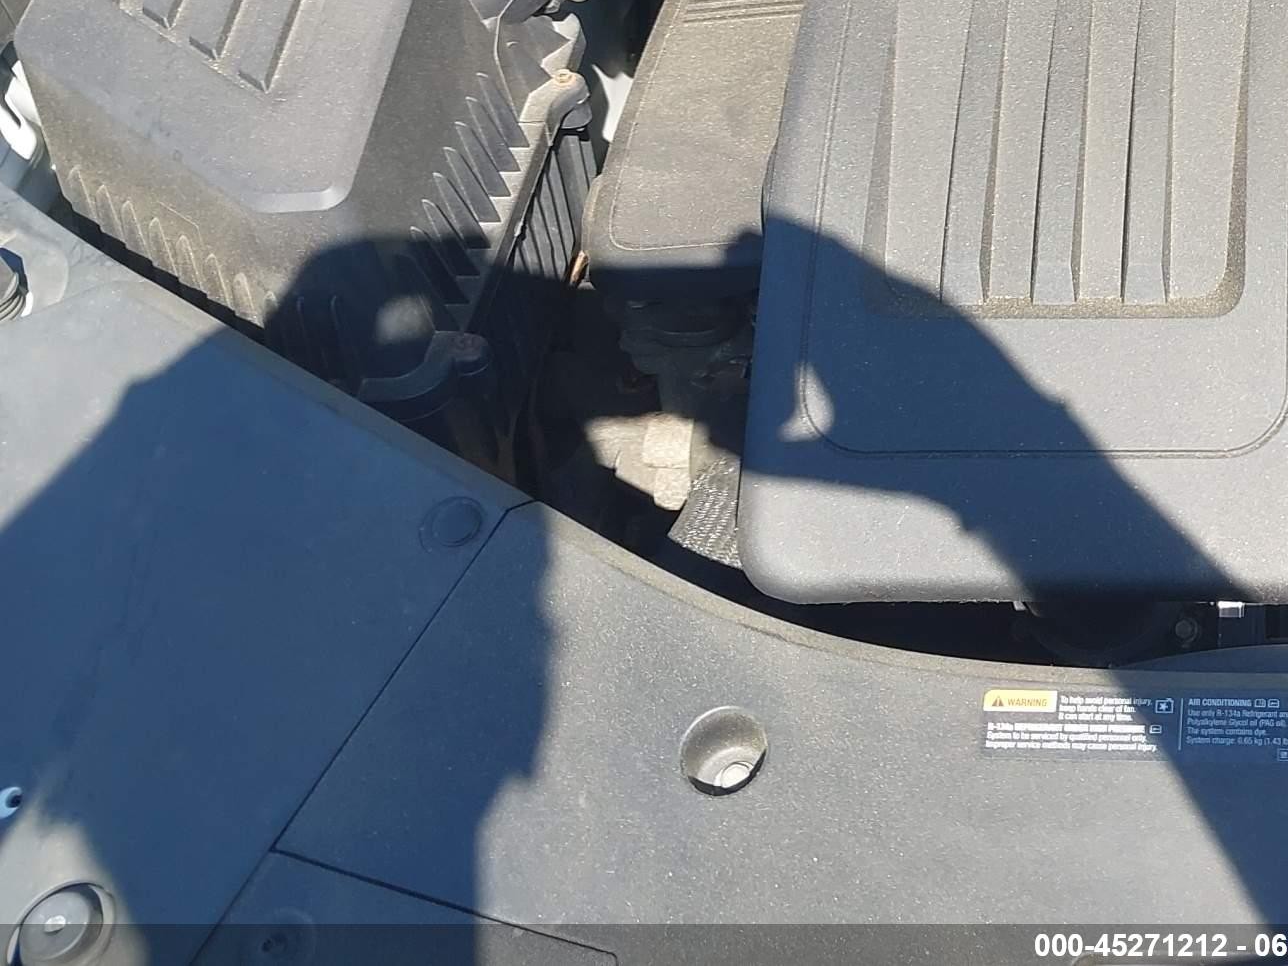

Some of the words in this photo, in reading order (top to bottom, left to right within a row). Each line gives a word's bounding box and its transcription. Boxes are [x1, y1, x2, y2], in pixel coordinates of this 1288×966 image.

[1008, 698, 1047, 706] WARNING
[1188, 698, 1200, 706] AIR
[1202, 698, 1252, 706] CONDITIONING
